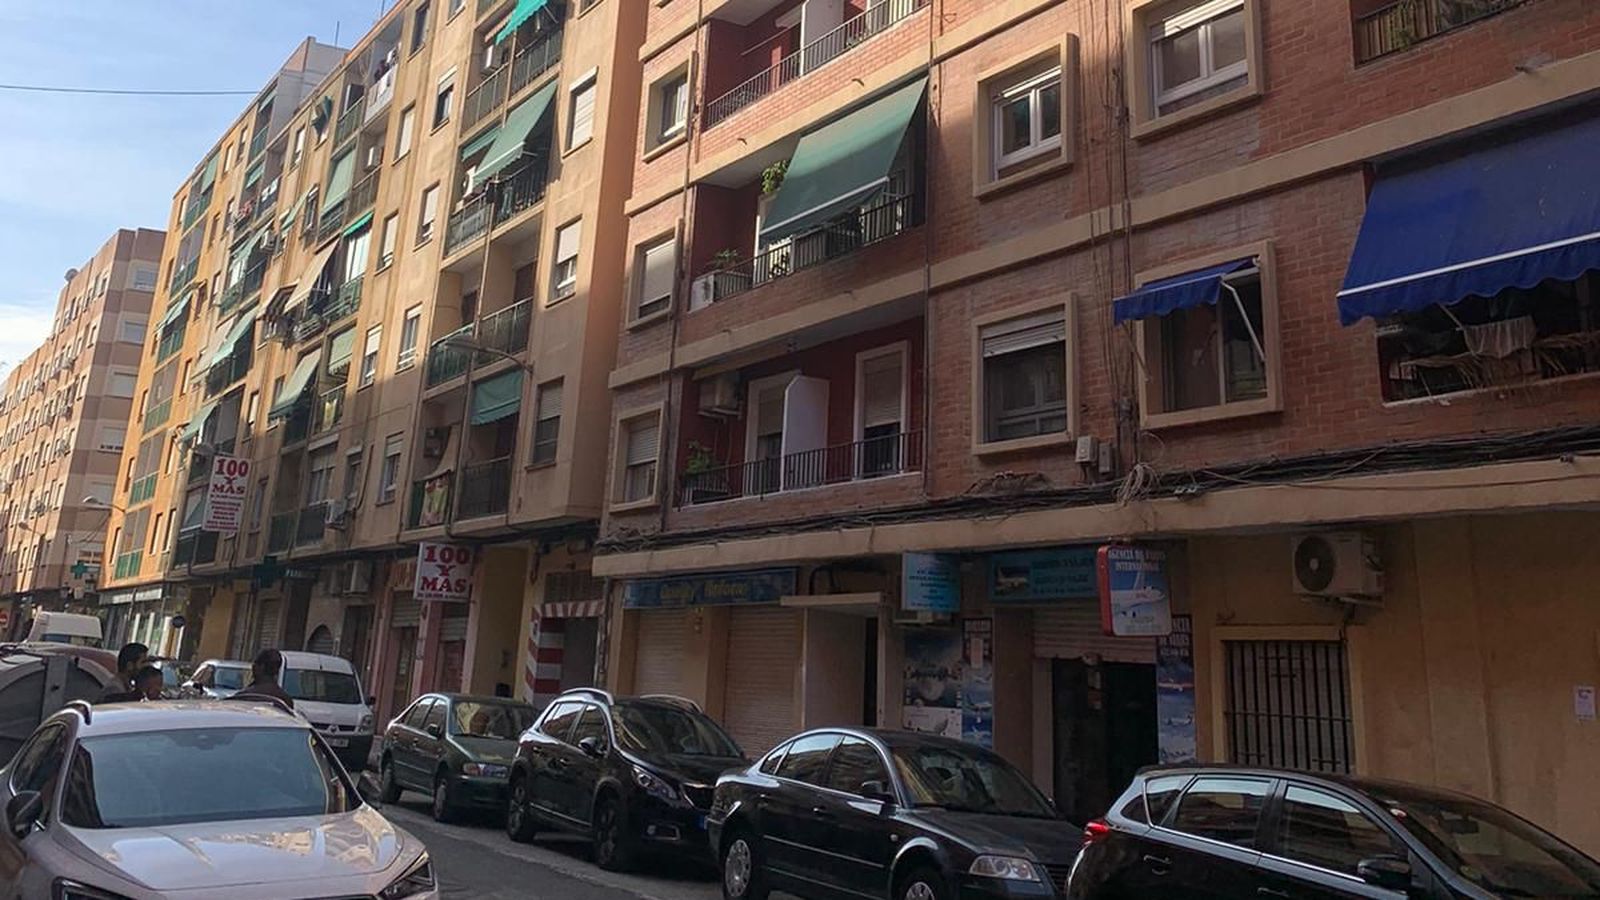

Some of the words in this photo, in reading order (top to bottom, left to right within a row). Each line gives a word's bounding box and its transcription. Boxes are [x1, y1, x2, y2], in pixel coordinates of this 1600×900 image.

[215, 459, 249, 477] 100
[224, 476, 237, 486] Y
[424, 545, 470, 564] 100
[435, 564, 456, 576] Y
